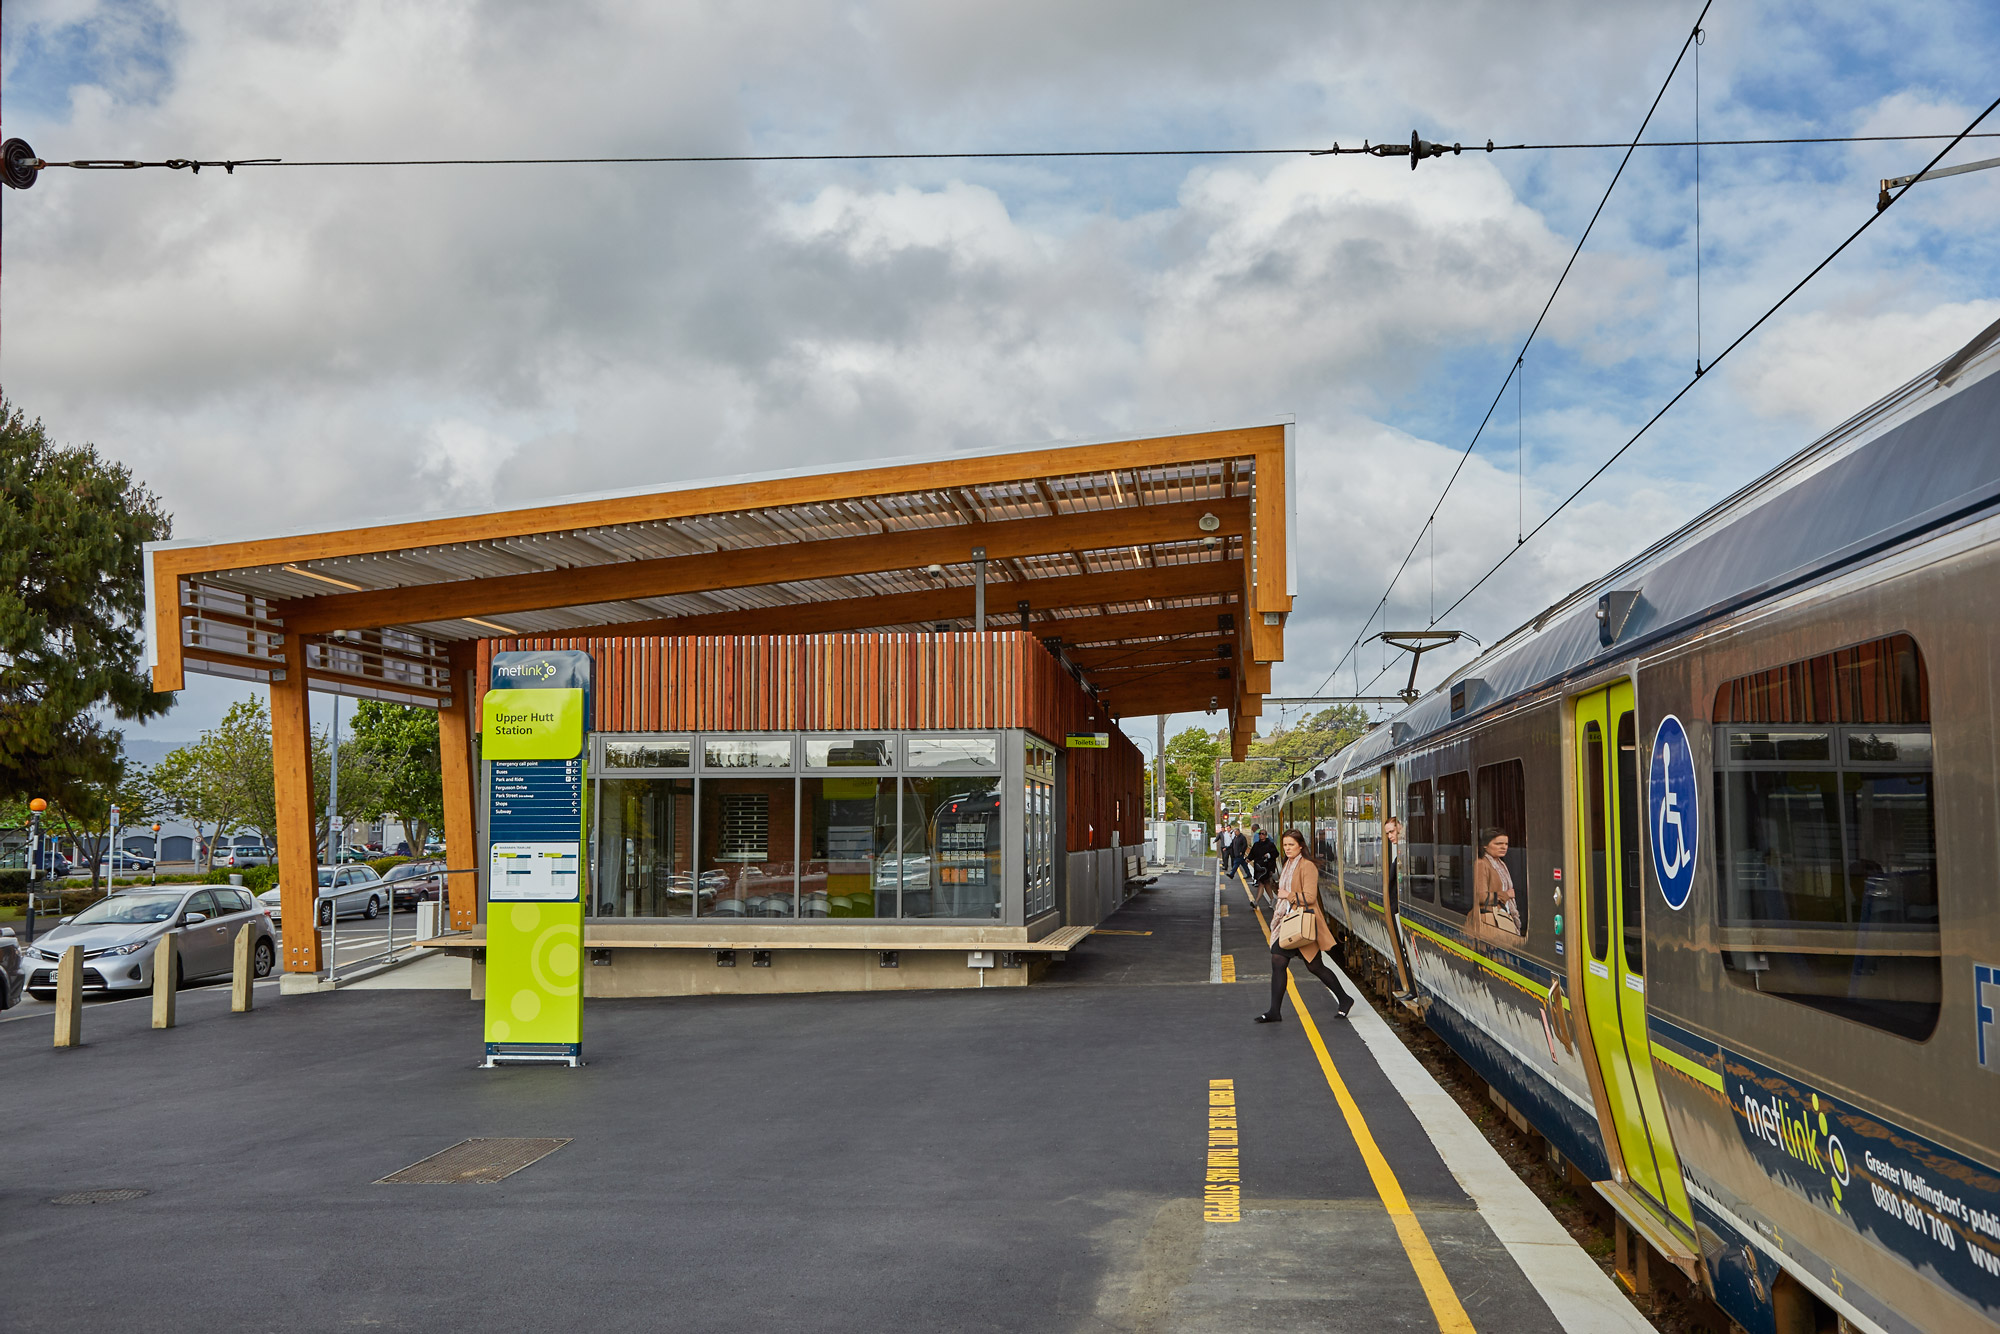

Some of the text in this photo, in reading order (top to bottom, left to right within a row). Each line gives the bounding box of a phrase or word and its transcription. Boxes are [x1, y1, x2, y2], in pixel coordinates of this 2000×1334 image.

[498, 665, 542, 677] metlink
[496, 713, 554, 724] Upper Hutt
[496, 725, 533, 735] Station
[1973, 963, 2000, 1067] F
[1743, 1094, 1827, 1175] metlink
[1206, 1148, 1239, 1168] TRAIN
[1204, 1168, 1240, 1183] HAS
[1865, 1150, 1901, 1186] Greater
[1900, 1167, 1969, 1223] Wellington's
[1203, 1184, 1241, 1223] STOPPED
[1871, 1182, 1902, 1220] 0800
[1901, 1199, 1928, 1235] 801
[1926, 1212, 1956, 1252] 700
